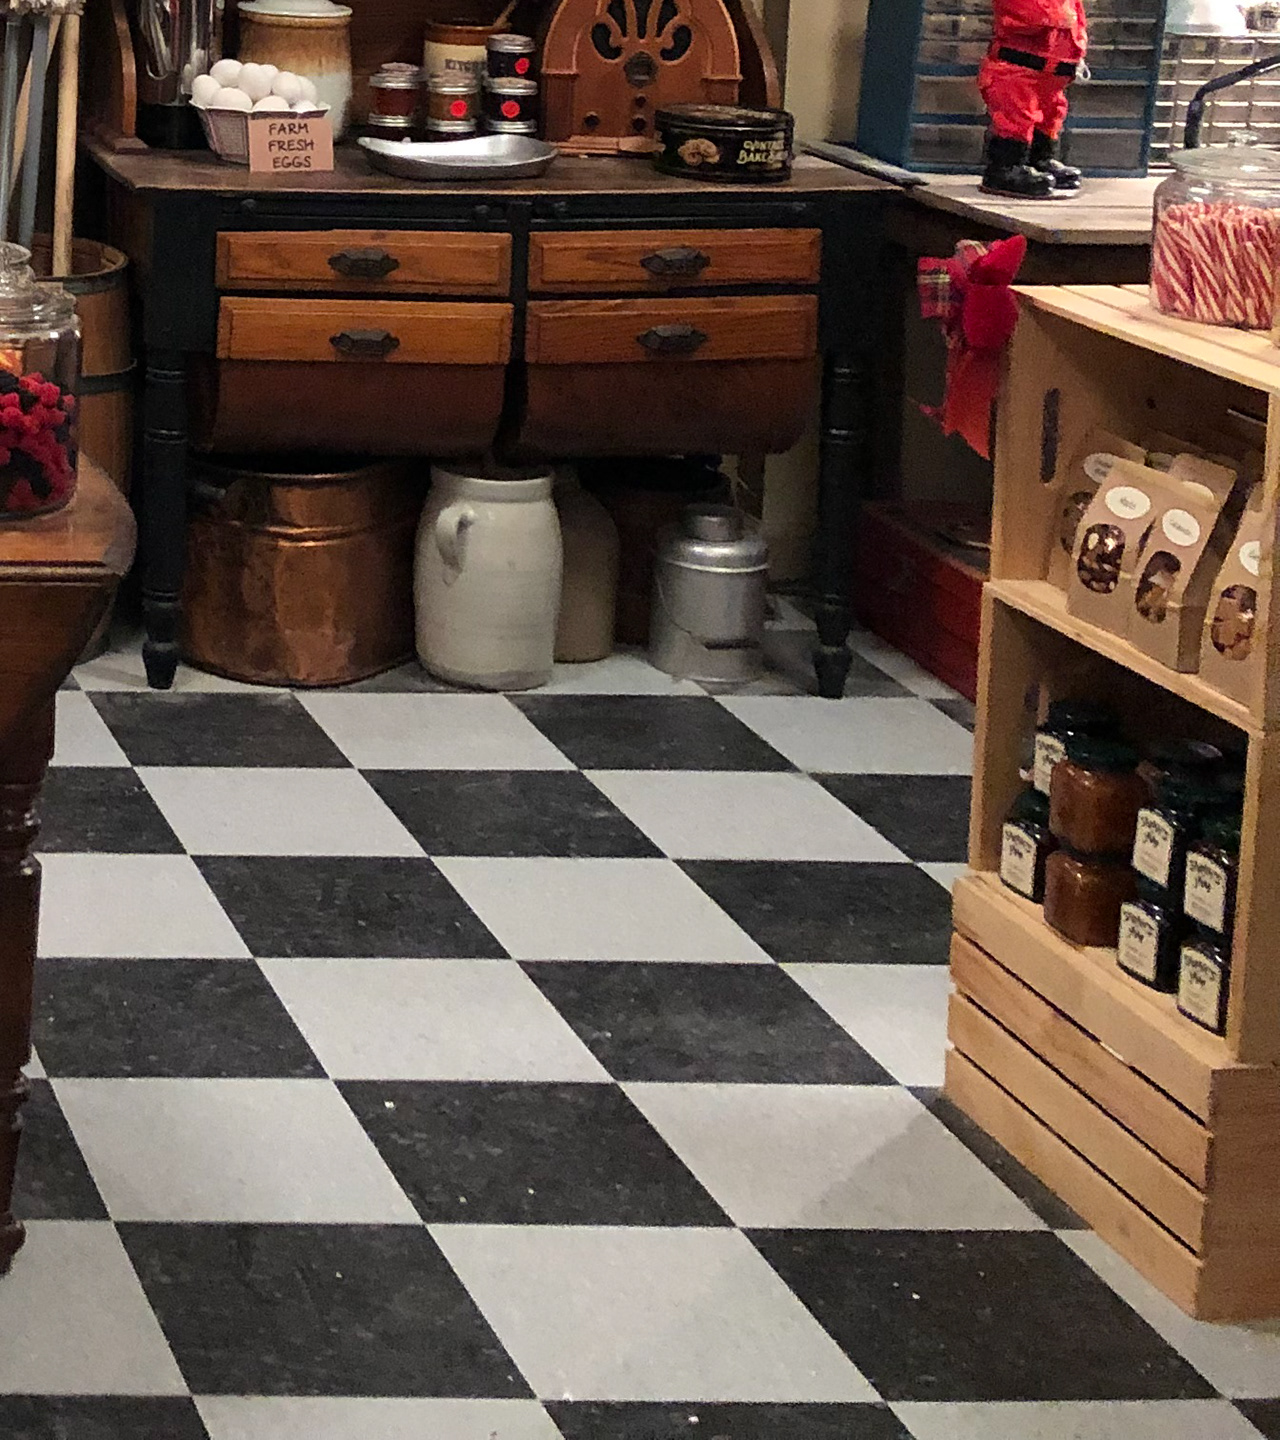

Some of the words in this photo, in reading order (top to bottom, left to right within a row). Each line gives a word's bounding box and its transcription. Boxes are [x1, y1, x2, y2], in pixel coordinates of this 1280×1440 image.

[269, 122, 309, 136] FARM
[268, 139, 315, 152] FRESH
[272, 156, 312, 169] EGGS
